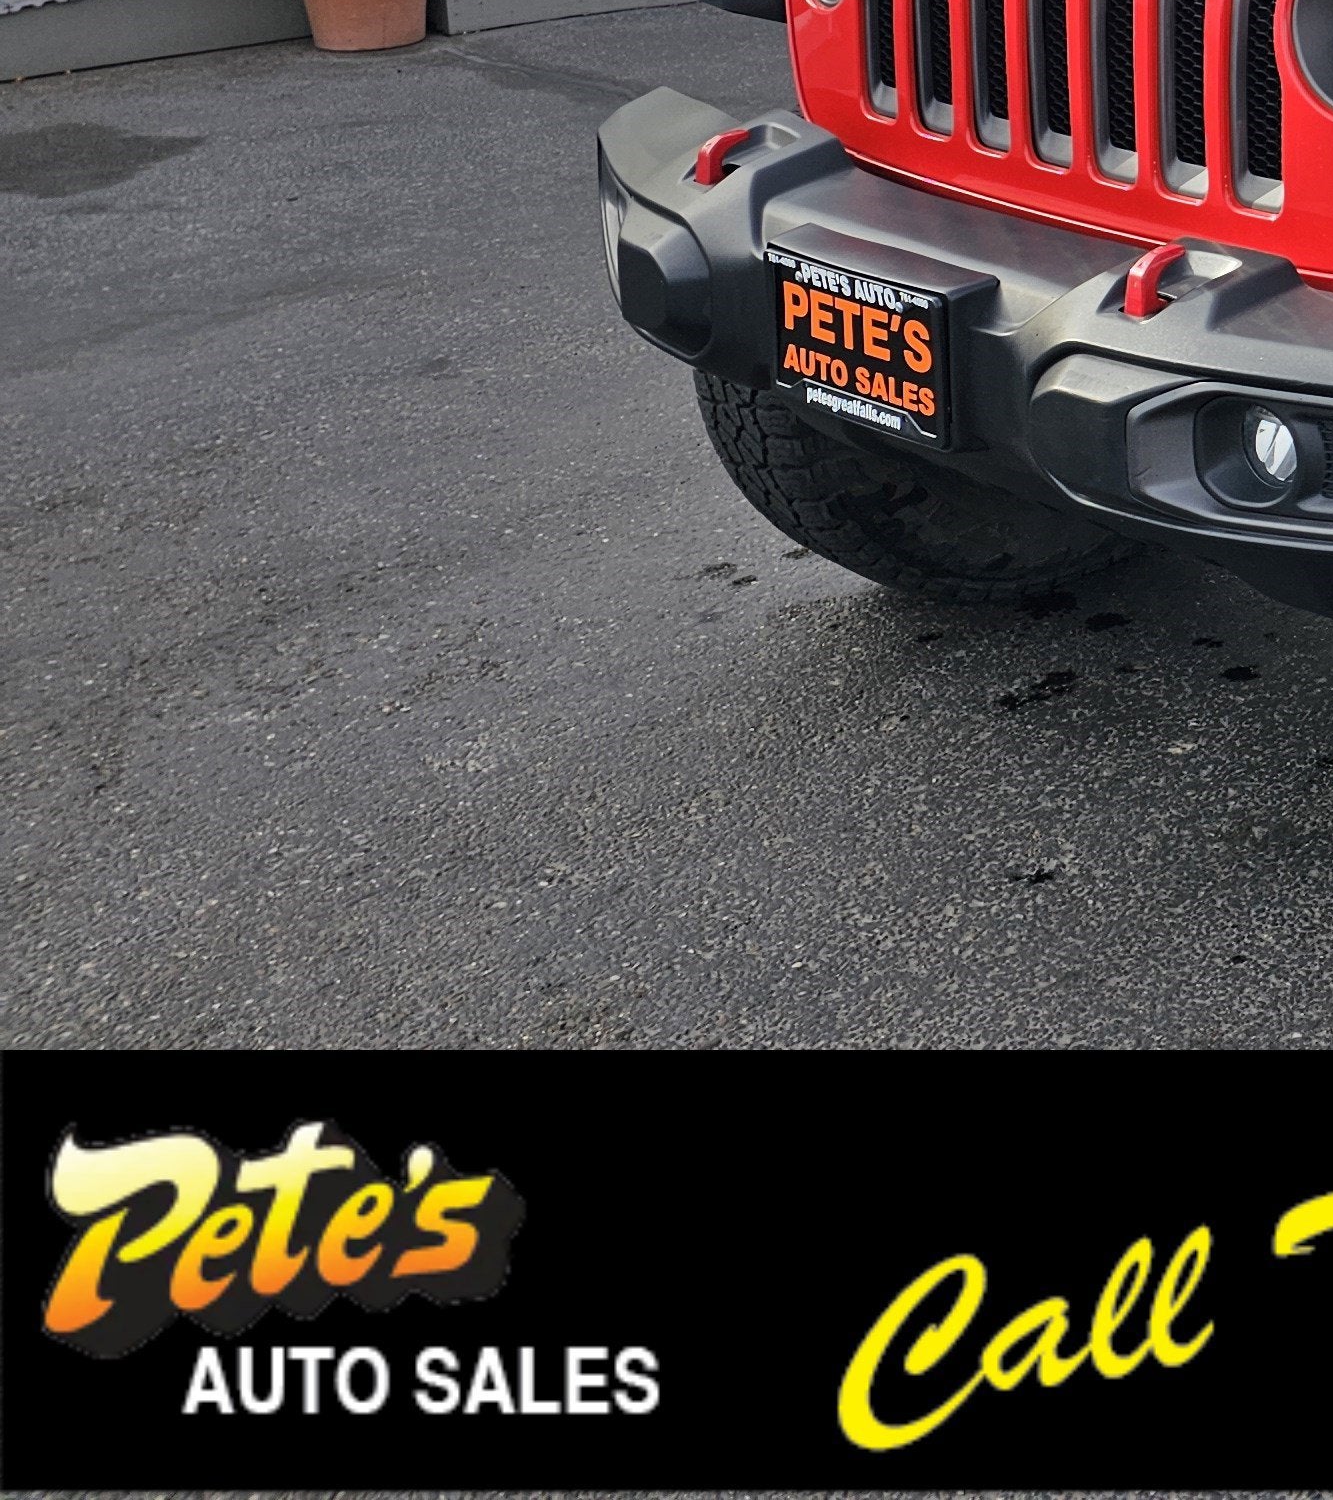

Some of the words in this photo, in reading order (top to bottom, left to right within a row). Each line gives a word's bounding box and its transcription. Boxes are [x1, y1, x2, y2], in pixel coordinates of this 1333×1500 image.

[801, 261, 852, 297] PETE'S
[854, 279, 897, 311] AUTO
[783, 280, 933, 374] PETE'S
[783, 343, 849, 387] AUTO
[855, 366, 935, 417] SALES
[806, 386, 901, 431] petesgreatfalls.com
